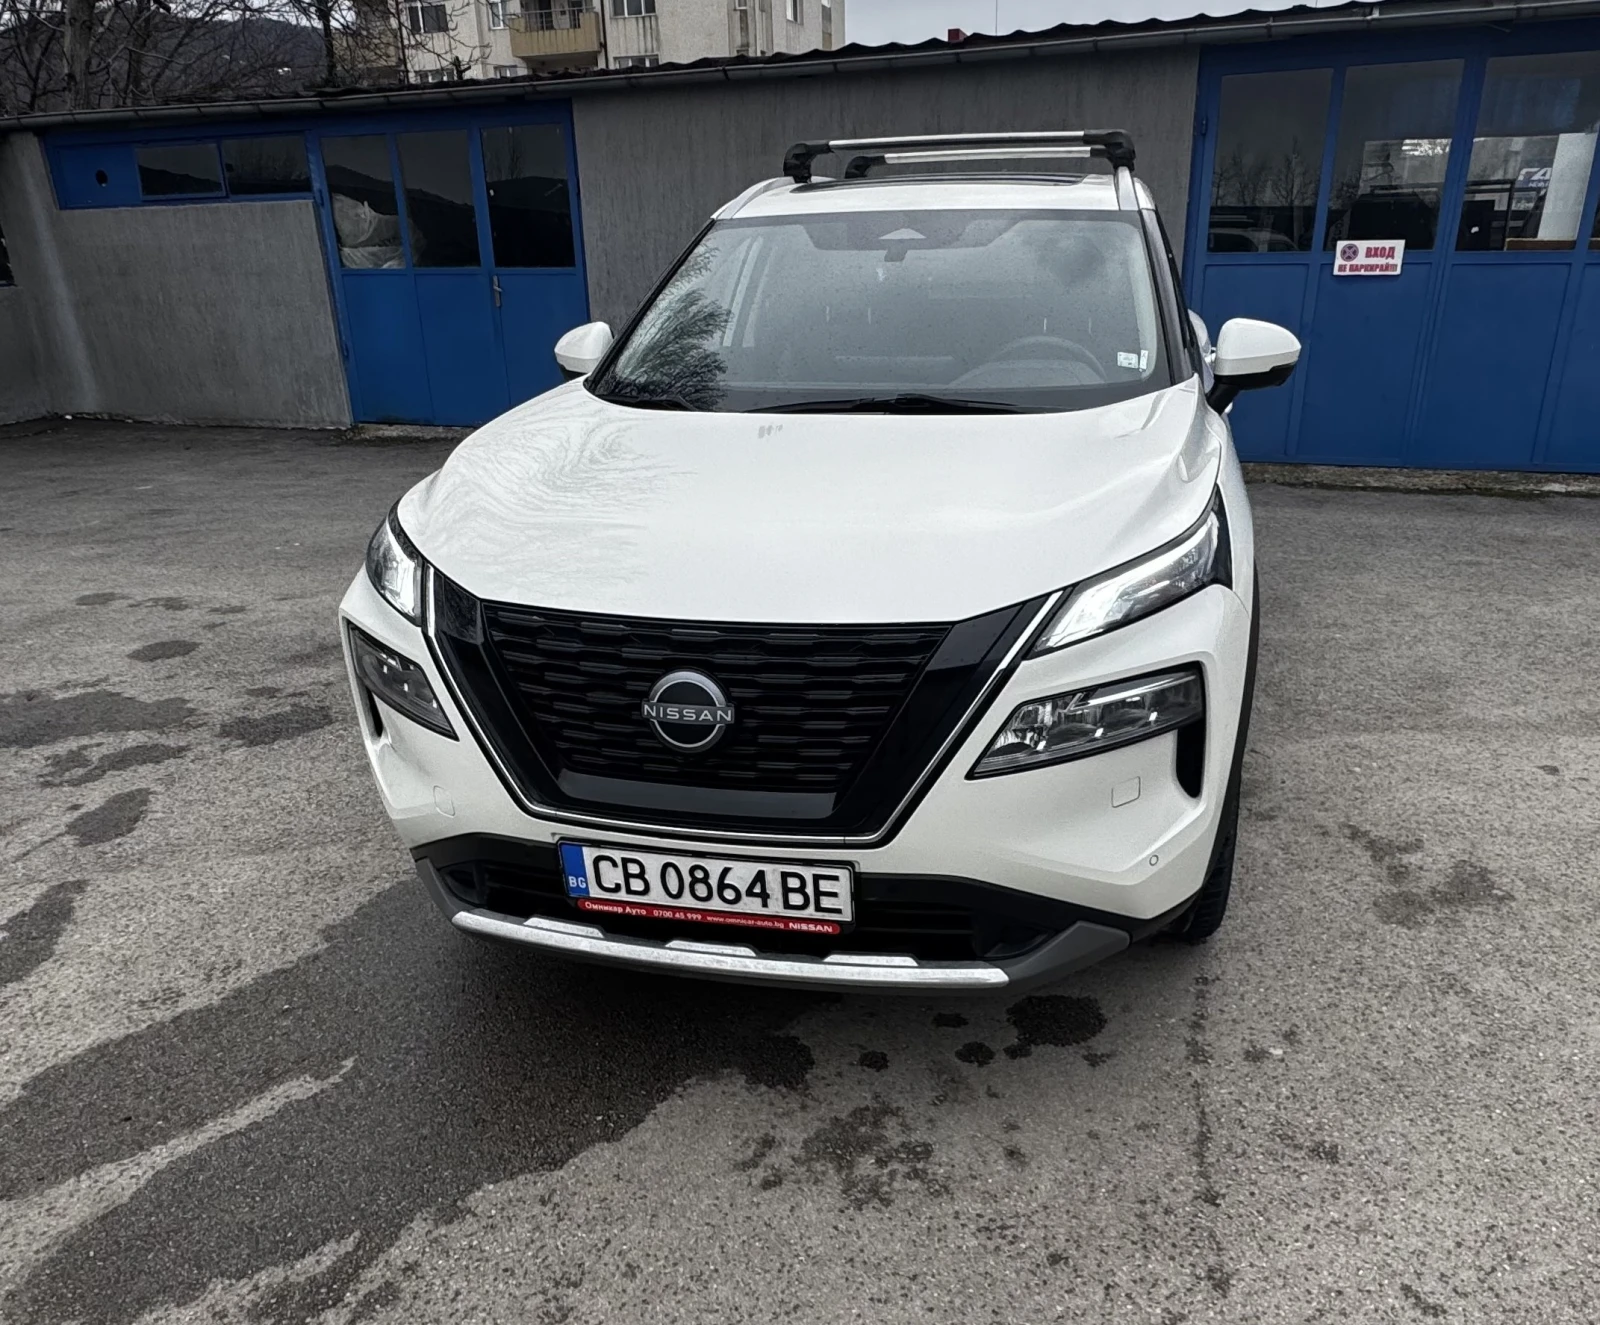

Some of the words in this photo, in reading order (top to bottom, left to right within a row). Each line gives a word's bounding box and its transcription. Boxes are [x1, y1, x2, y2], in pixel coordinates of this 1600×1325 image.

[1365, 246, 1396, 260] ВХОД
[1337, 264, 1348, 273] НЕ
[644, 704, 731, 721] NISSAN
[569, 875, 587, 890] BG
[592, 854, 650, 896] CB
[660, 861, 770, 908] 0864
[780, 871, 843, 915] BE
[585, 902, 623, 914] Омникар
[625, 906, 647, 915] Ауто
[653, 910, 673, 918] 0700
[706, 915, 784, 928] www.omnicar-auto.bg
[789, 922, 833, 933] NISSAN
